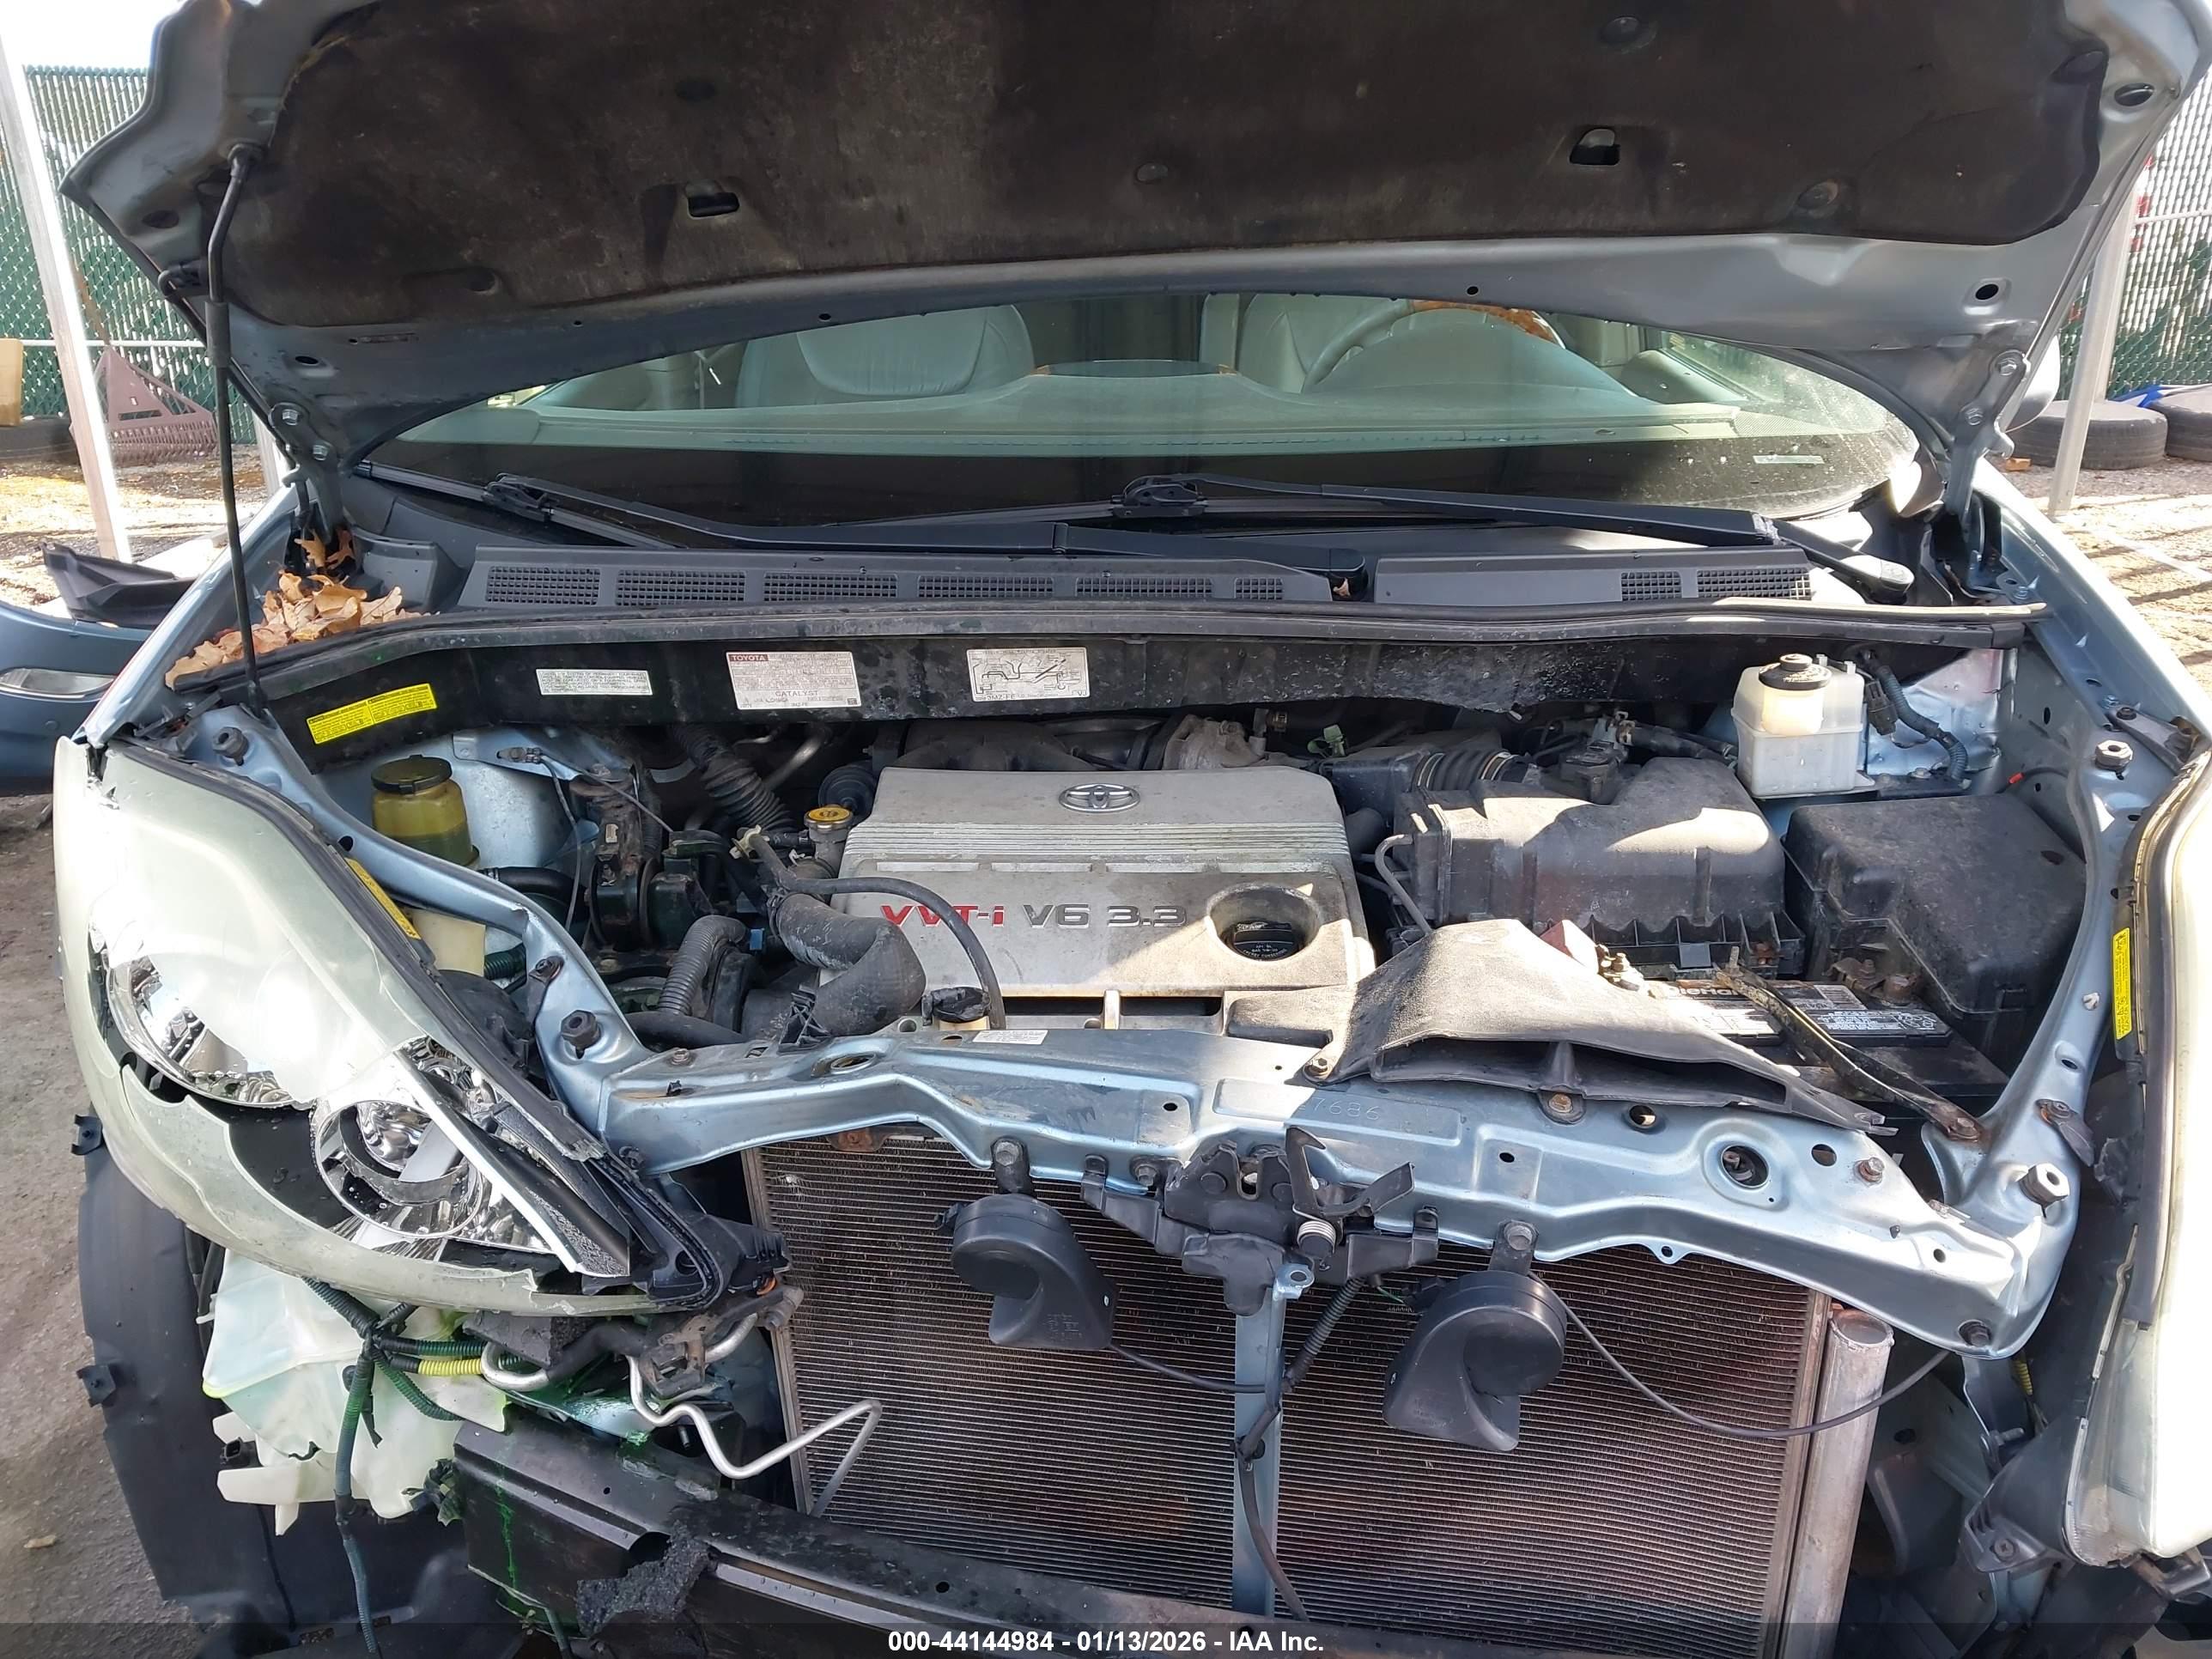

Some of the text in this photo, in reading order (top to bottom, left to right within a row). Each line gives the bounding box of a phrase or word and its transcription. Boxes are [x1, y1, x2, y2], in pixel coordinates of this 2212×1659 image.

[881, 904, 1187, 928] VVT-i V6 3.3
